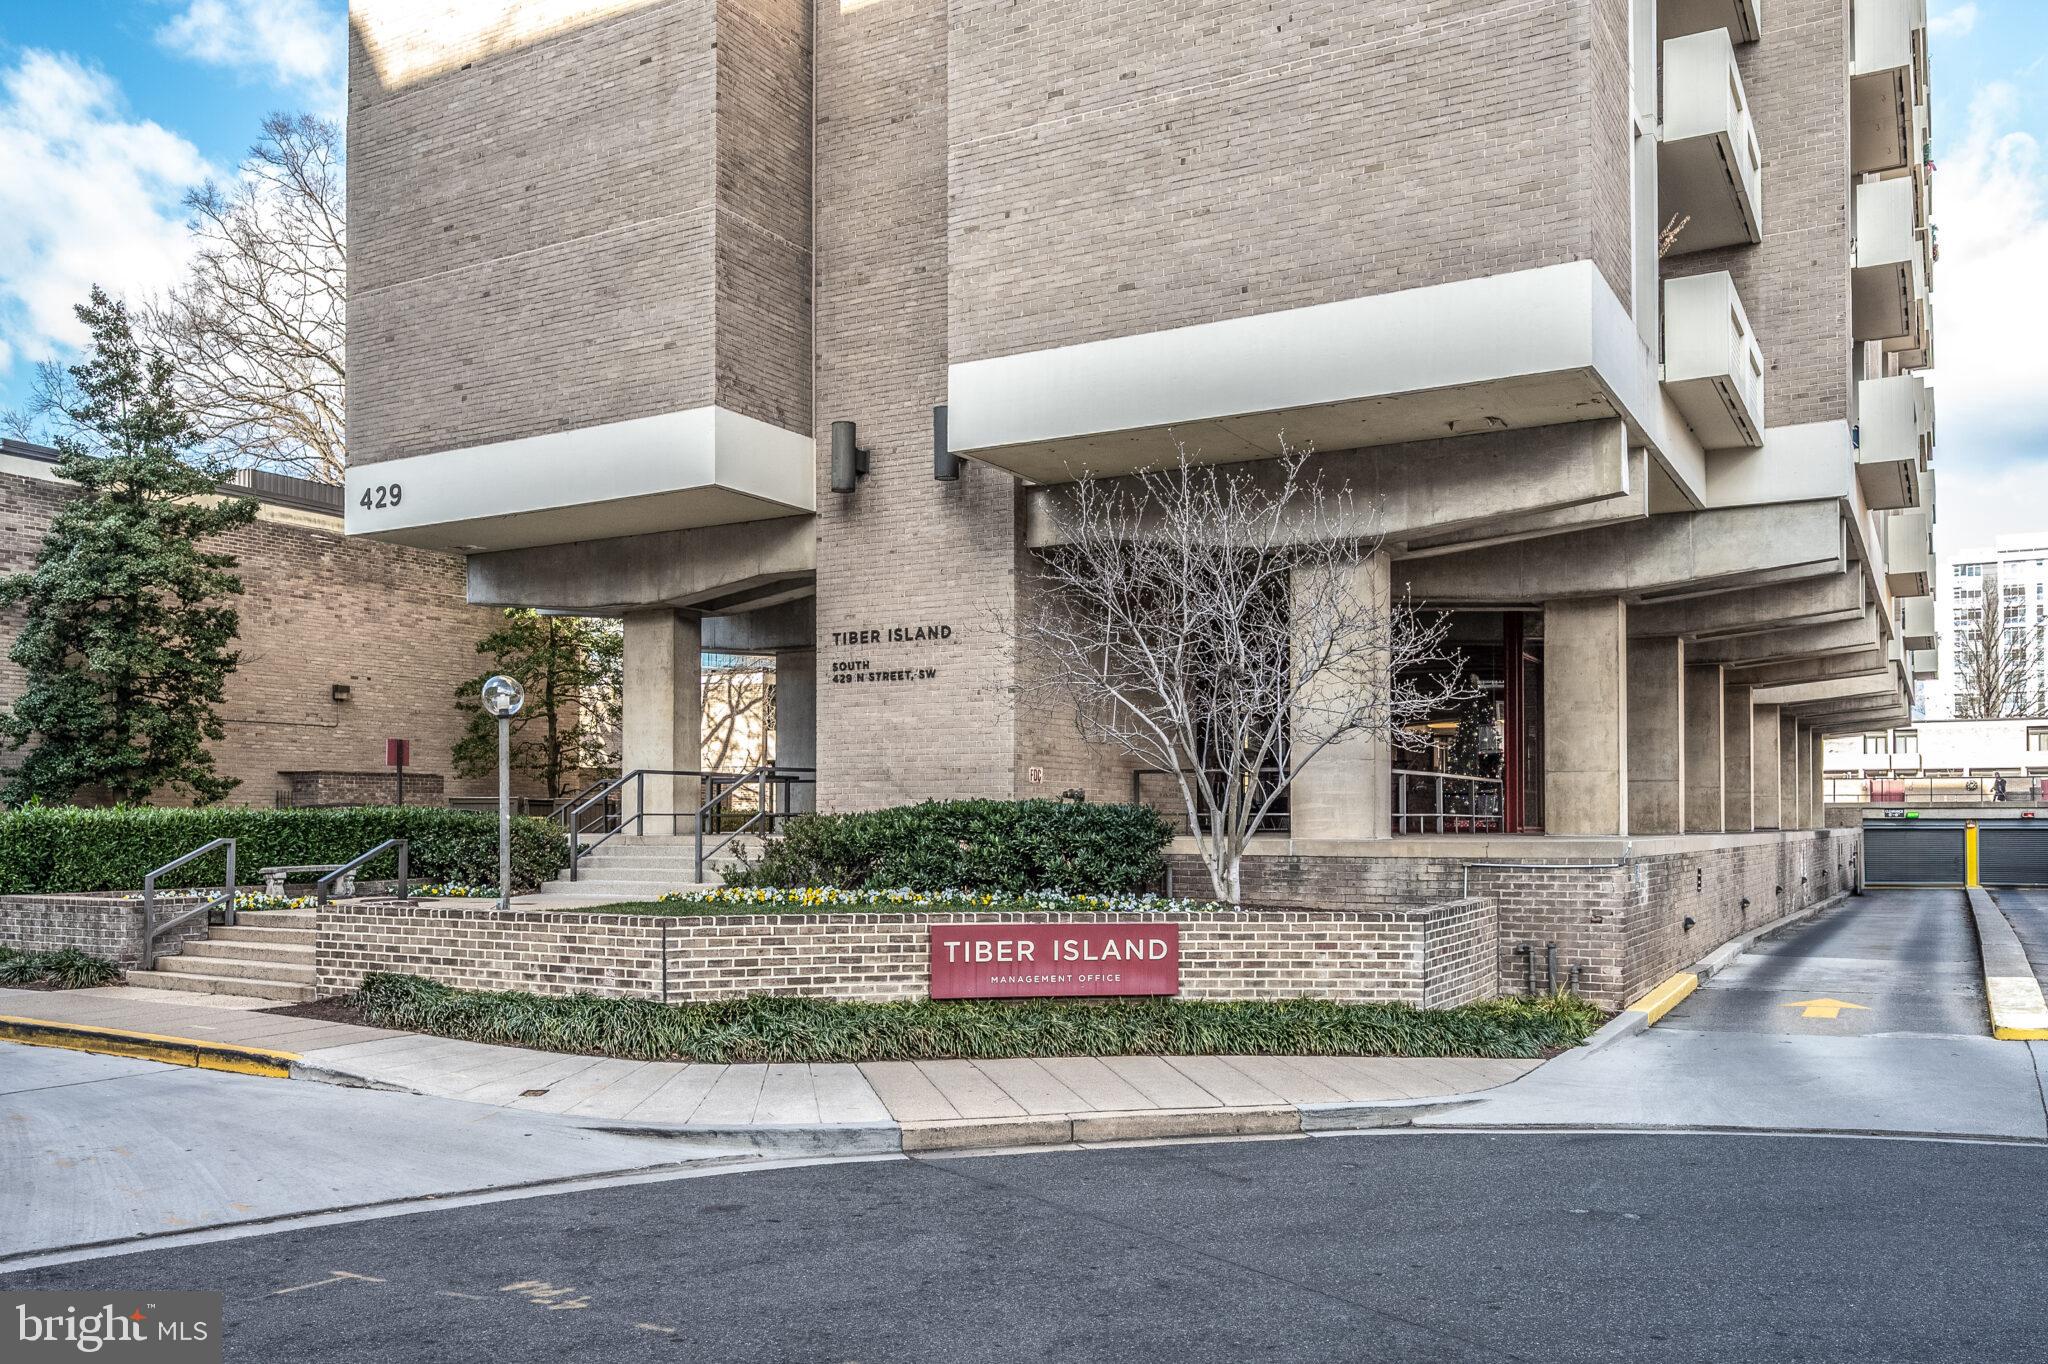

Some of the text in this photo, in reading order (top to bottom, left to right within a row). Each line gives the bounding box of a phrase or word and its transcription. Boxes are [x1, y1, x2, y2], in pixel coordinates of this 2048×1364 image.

[360, 483, 402, 510] 429
[832, 625, 952, 646] TIBER ISLAND
[832, 660, 870, 672] SOUTH
[832, 669, 936, 684] 429 N STREET, SW
[1030, 769, 1042, 782] FDC
[943, 939, 1168, 963] TIBER ISLAND
[990, 974, 1121, 984] MANAGEMENT OFFICE
